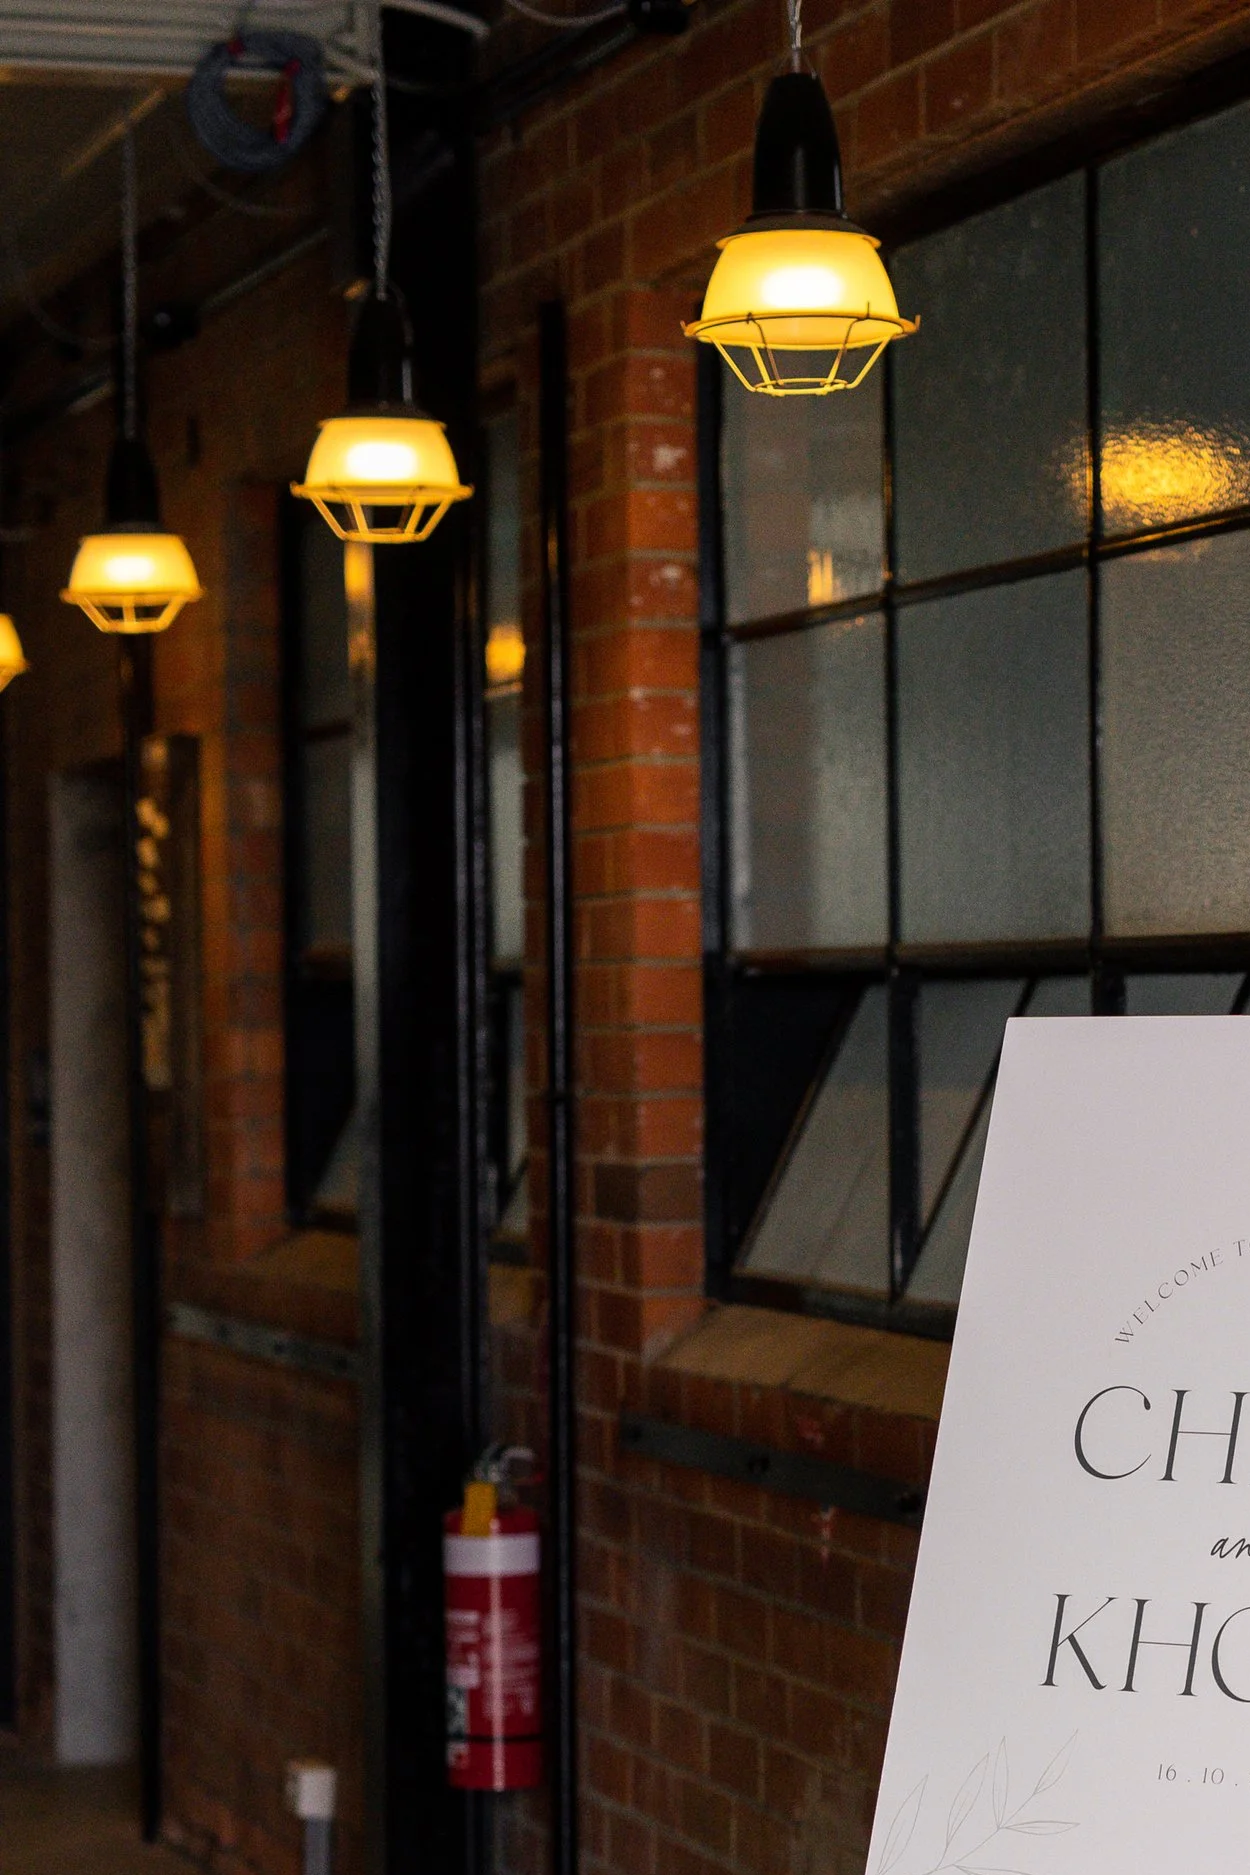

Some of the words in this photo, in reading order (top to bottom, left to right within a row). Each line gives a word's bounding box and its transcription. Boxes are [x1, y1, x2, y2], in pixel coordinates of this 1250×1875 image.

[1114, 1248, 1224, 1345] WELCOME
[1157, 1763, 1177, 1781] 16
[1202, 1767, 1225, 1785] 10
